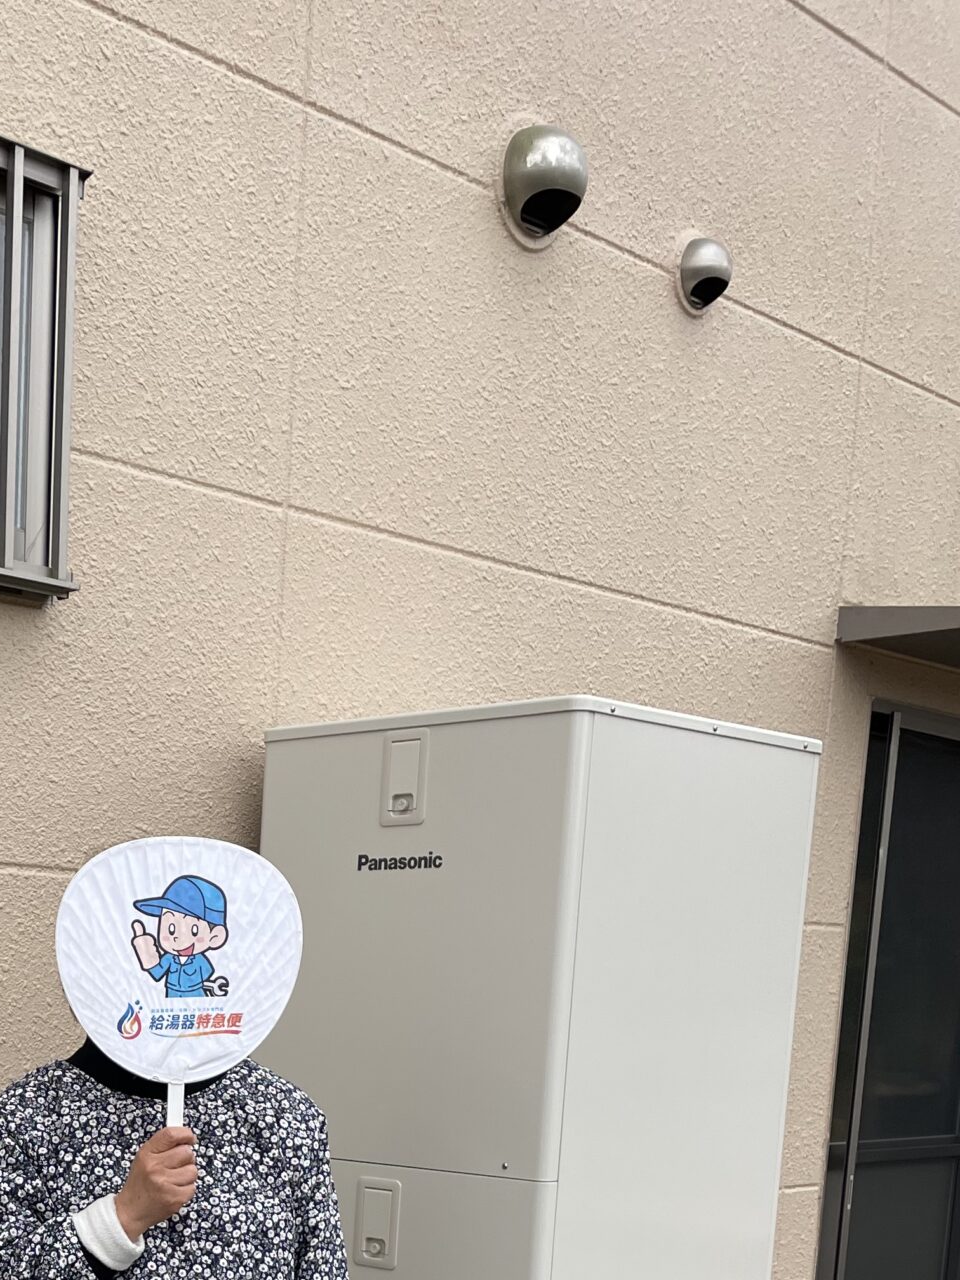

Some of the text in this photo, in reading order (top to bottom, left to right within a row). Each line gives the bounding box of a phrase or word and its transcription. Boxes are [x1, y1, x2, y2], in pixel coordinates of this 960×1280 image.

[357, 851, 443, 871] Panasonic
[149, 1012, 243, 1031] 給湯器特急便
